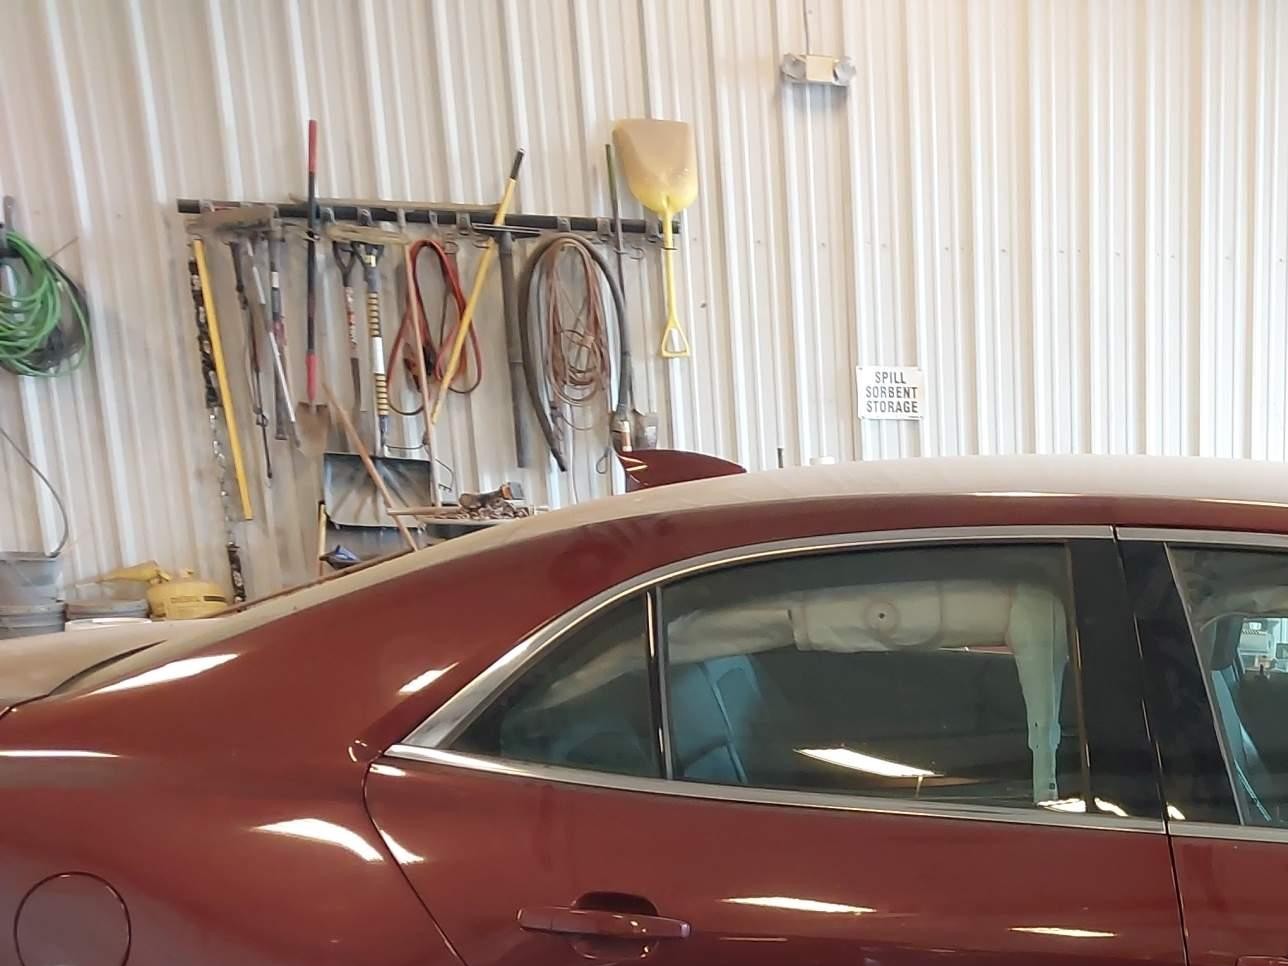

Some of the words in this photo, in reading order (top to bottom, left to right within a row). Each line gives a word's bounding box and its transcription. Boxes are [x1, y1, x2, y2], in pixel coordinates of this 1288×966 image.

[875, 371, 906, 384] SPILL
[865, 386, 918, 399] SORBENT
[866, 400, 918, 413] STORAGE
